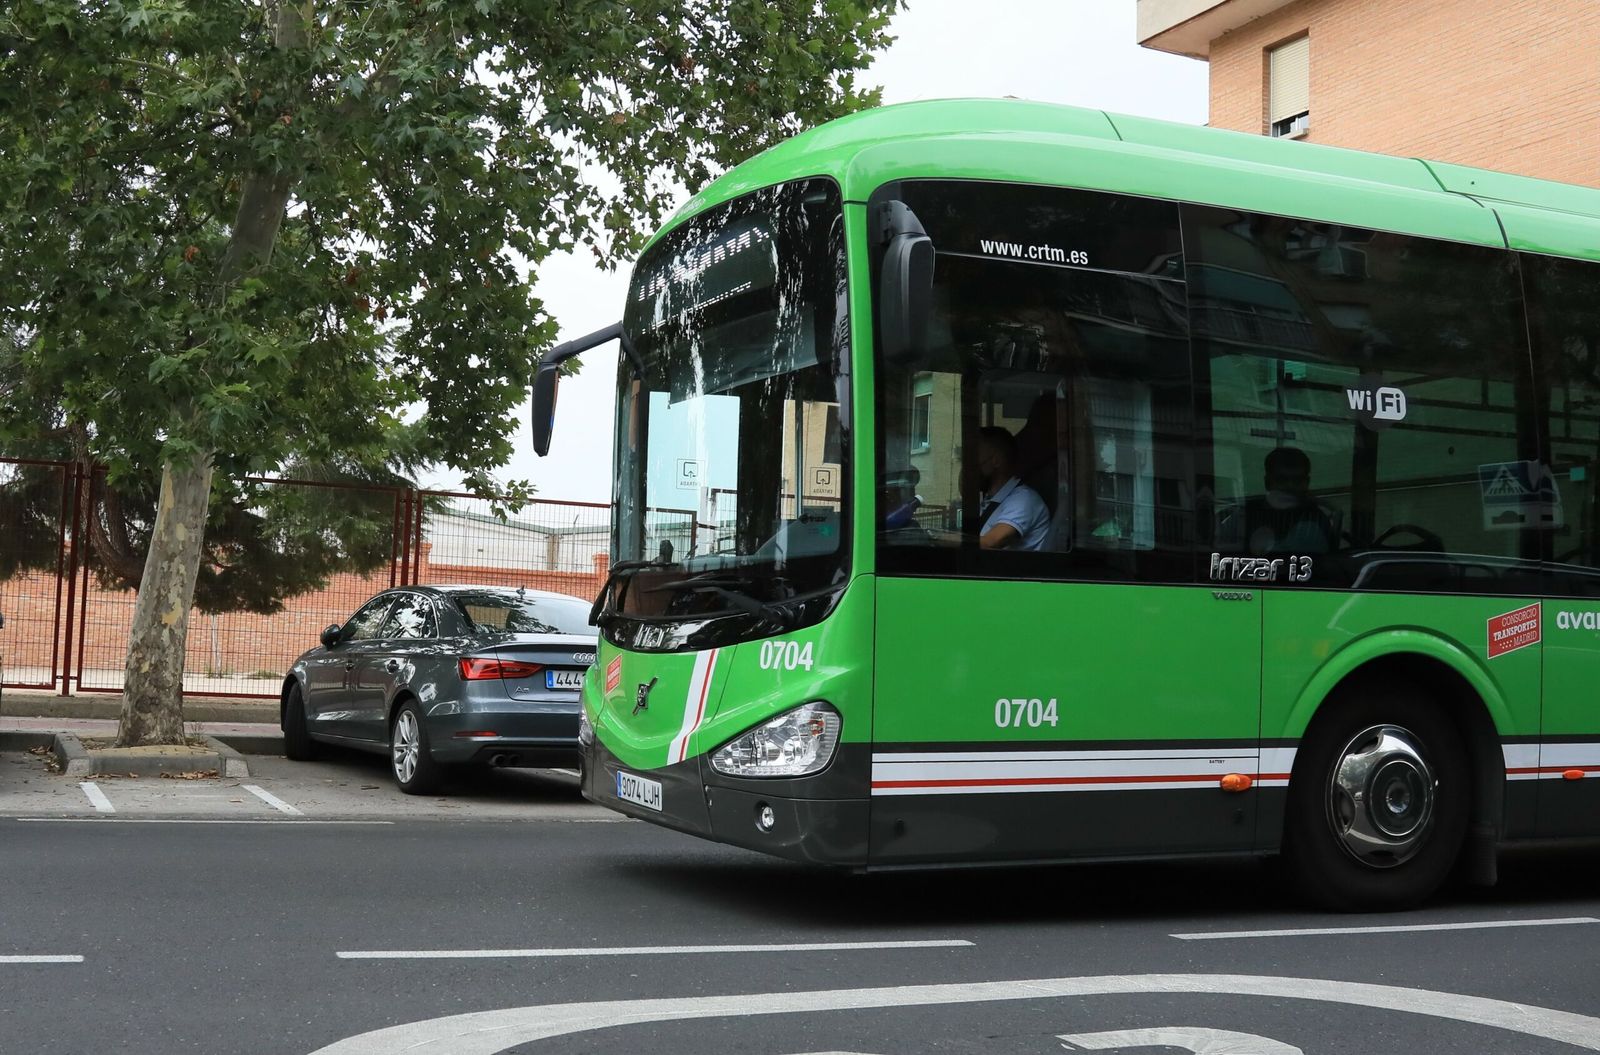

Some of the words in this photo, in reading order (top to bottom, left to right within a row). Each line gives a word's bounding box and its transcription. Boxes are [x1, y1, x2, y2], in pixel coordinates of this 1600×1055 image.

[980, 239, 1089, 265] www.crtm.es
[1210, 552, 1284, 581] Irizar
[1288, 555, 1313, 582] i3
[1501, 607, 1537, 627] CONSORCIO
[1556, 611, 1600, 630] ava
[1493, 619, 1537, 642] TRANSPORTES
[1513, 630, 1538, 648] MADRID
[760, 641, 813, 671] 0704
[995, 698, 1059, 728] 0704
[622, 776, 641, 801] 9074
[643, 782, 660, 808] LJH
